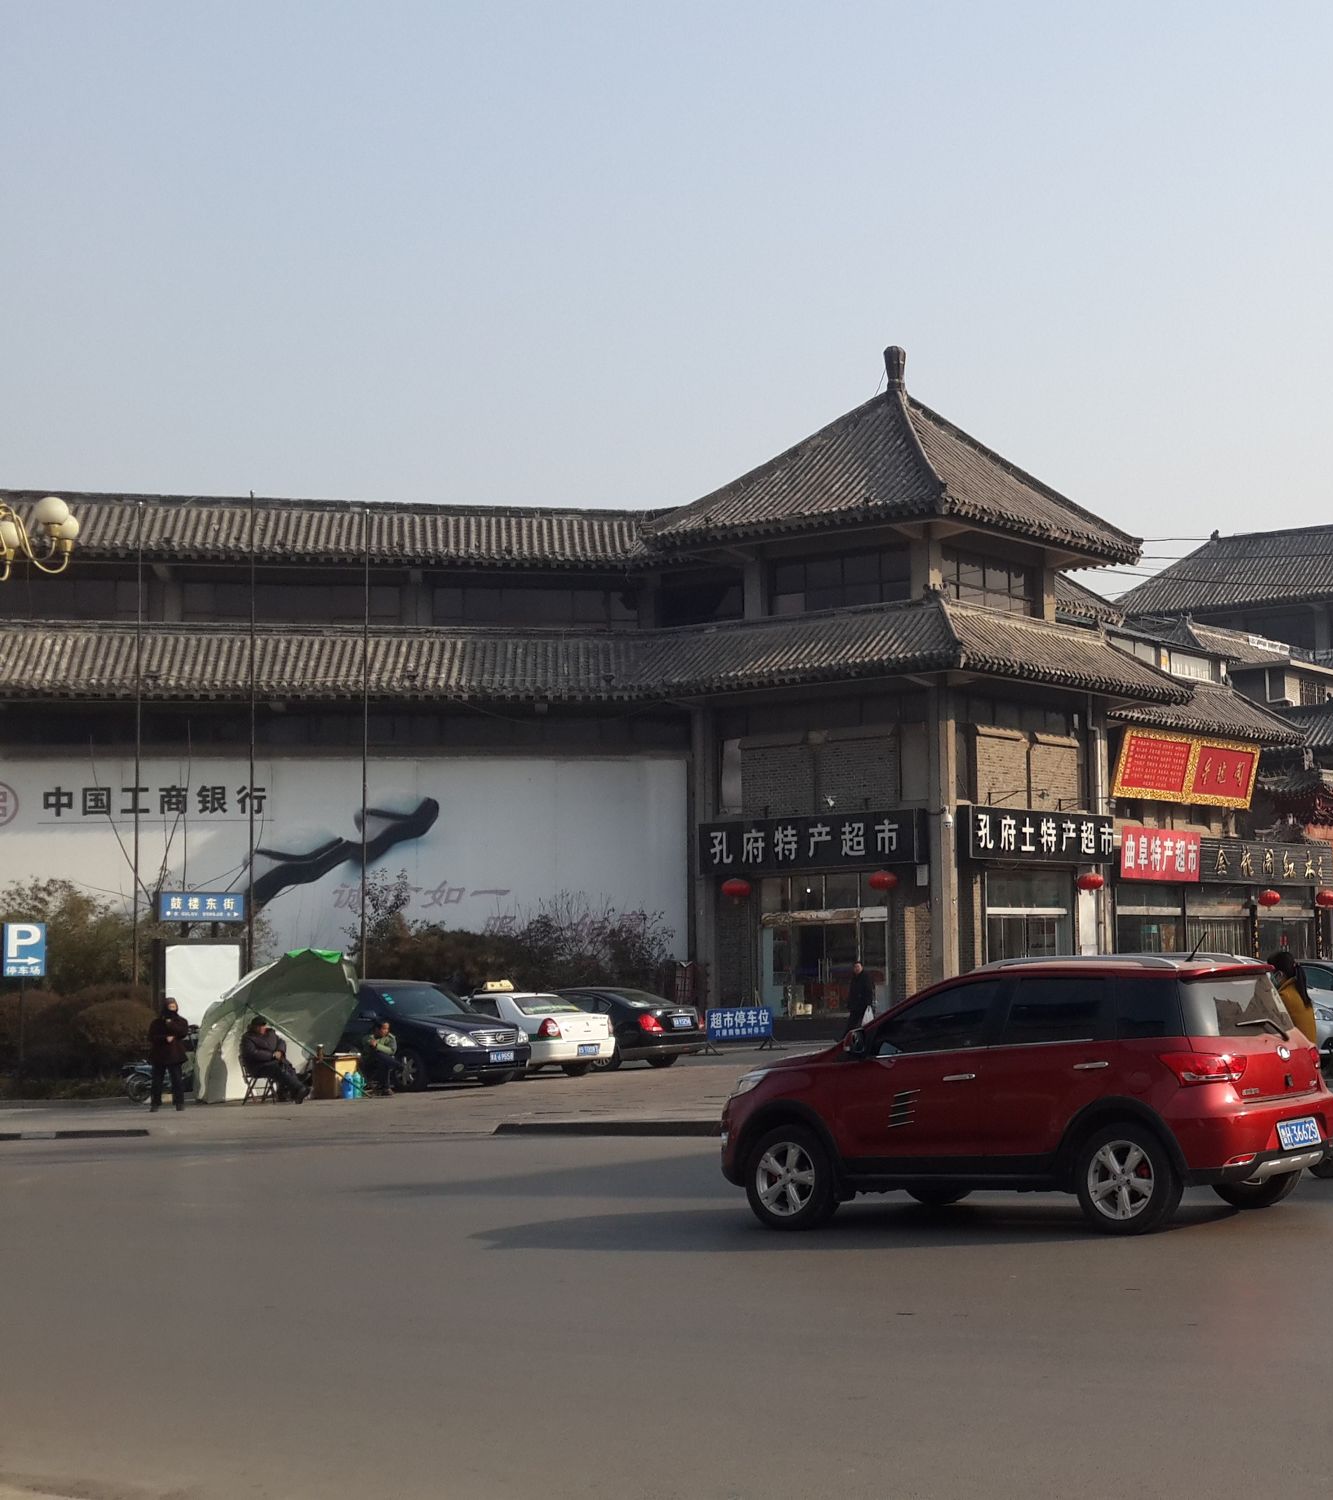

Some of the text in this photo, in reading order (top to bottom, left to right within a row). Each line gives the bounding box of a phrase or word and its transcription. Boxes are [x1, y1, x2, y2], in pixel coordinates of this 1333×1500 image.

[43, 785, 267, 817] 中国工商银行
[710, 819, 899, 864] 孔府特产超市
[977, 814, 1114, 856] 孔府土特产超市
[1124, 833, 1198, 874] 曲阜特产超市
[170, 896, 235, 910] 鼓楼东街
[7, 924, 41, 958] P
[6, 965, 41, 976] 停车场
[710, 1009, 770, 1029] 超市停车位
